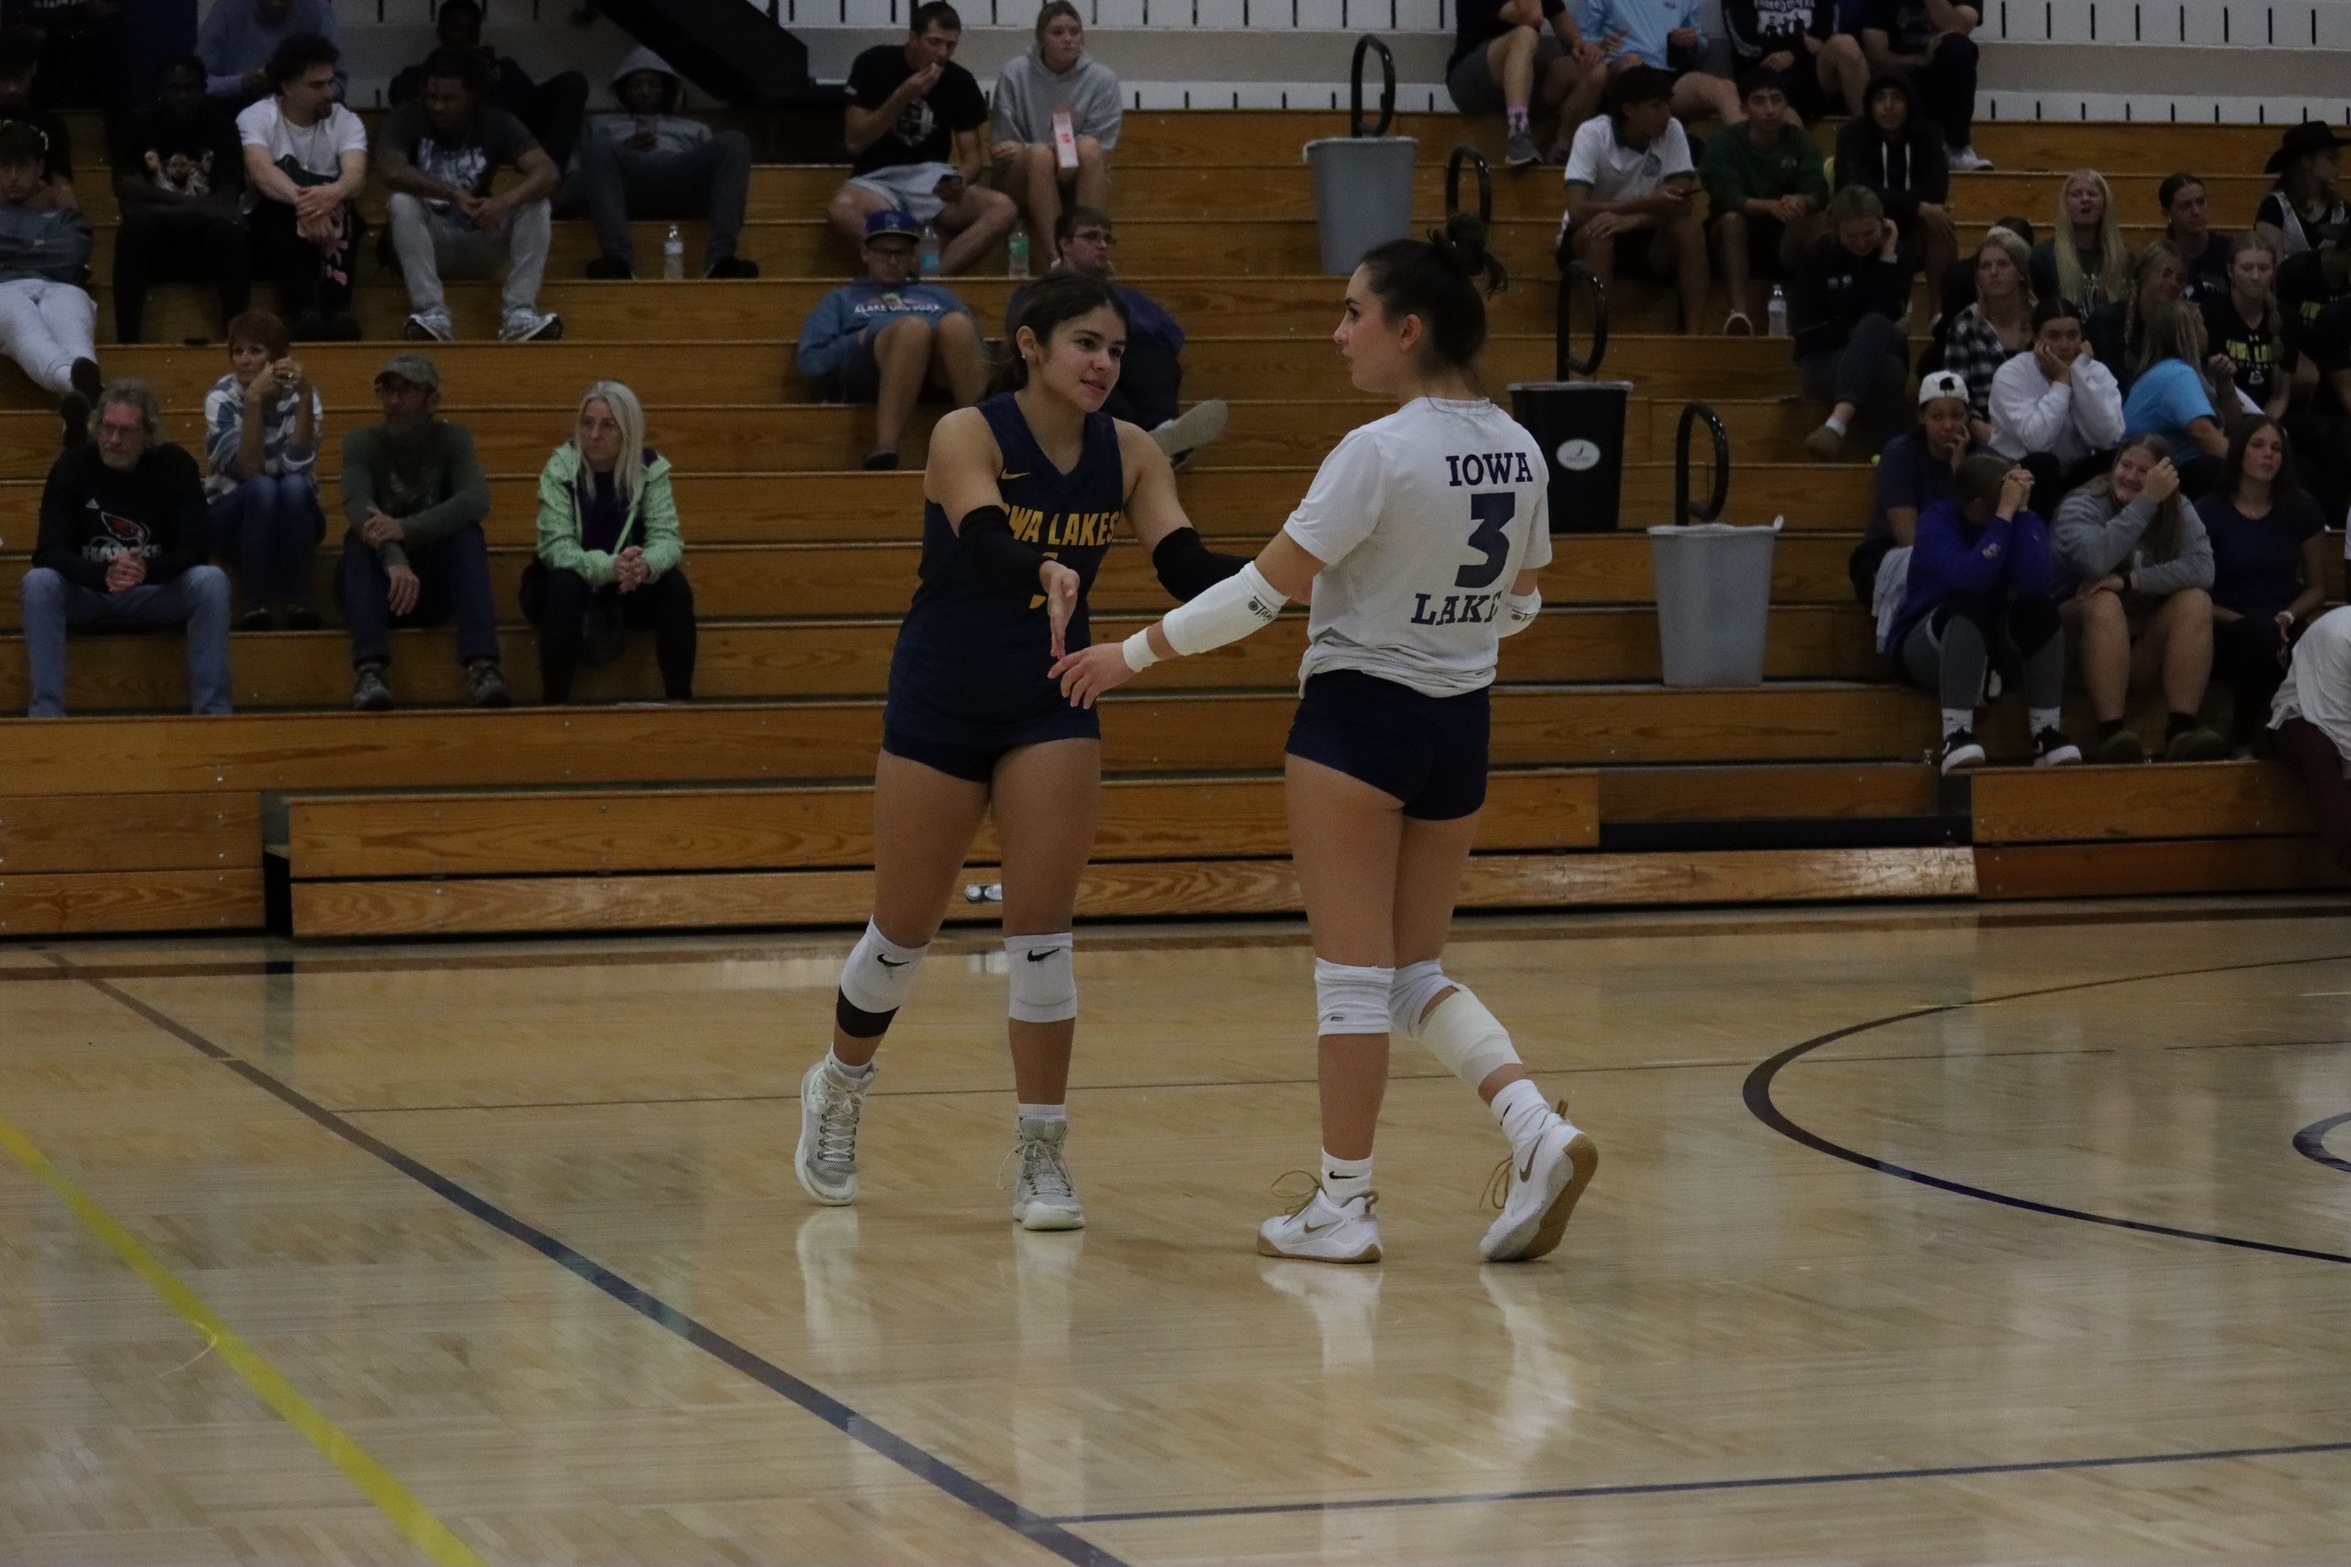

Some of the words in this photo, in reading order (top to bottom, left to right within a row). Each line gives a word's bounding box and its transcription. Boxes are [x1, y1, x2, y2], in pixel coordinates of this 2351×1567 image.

[1446, 452, 1533, 486] IOWA
[1008, 505, 1044, 544] WA
[1046, 510, 1121, 547] LAKES
[1454, 492, 1516, 588] 3
